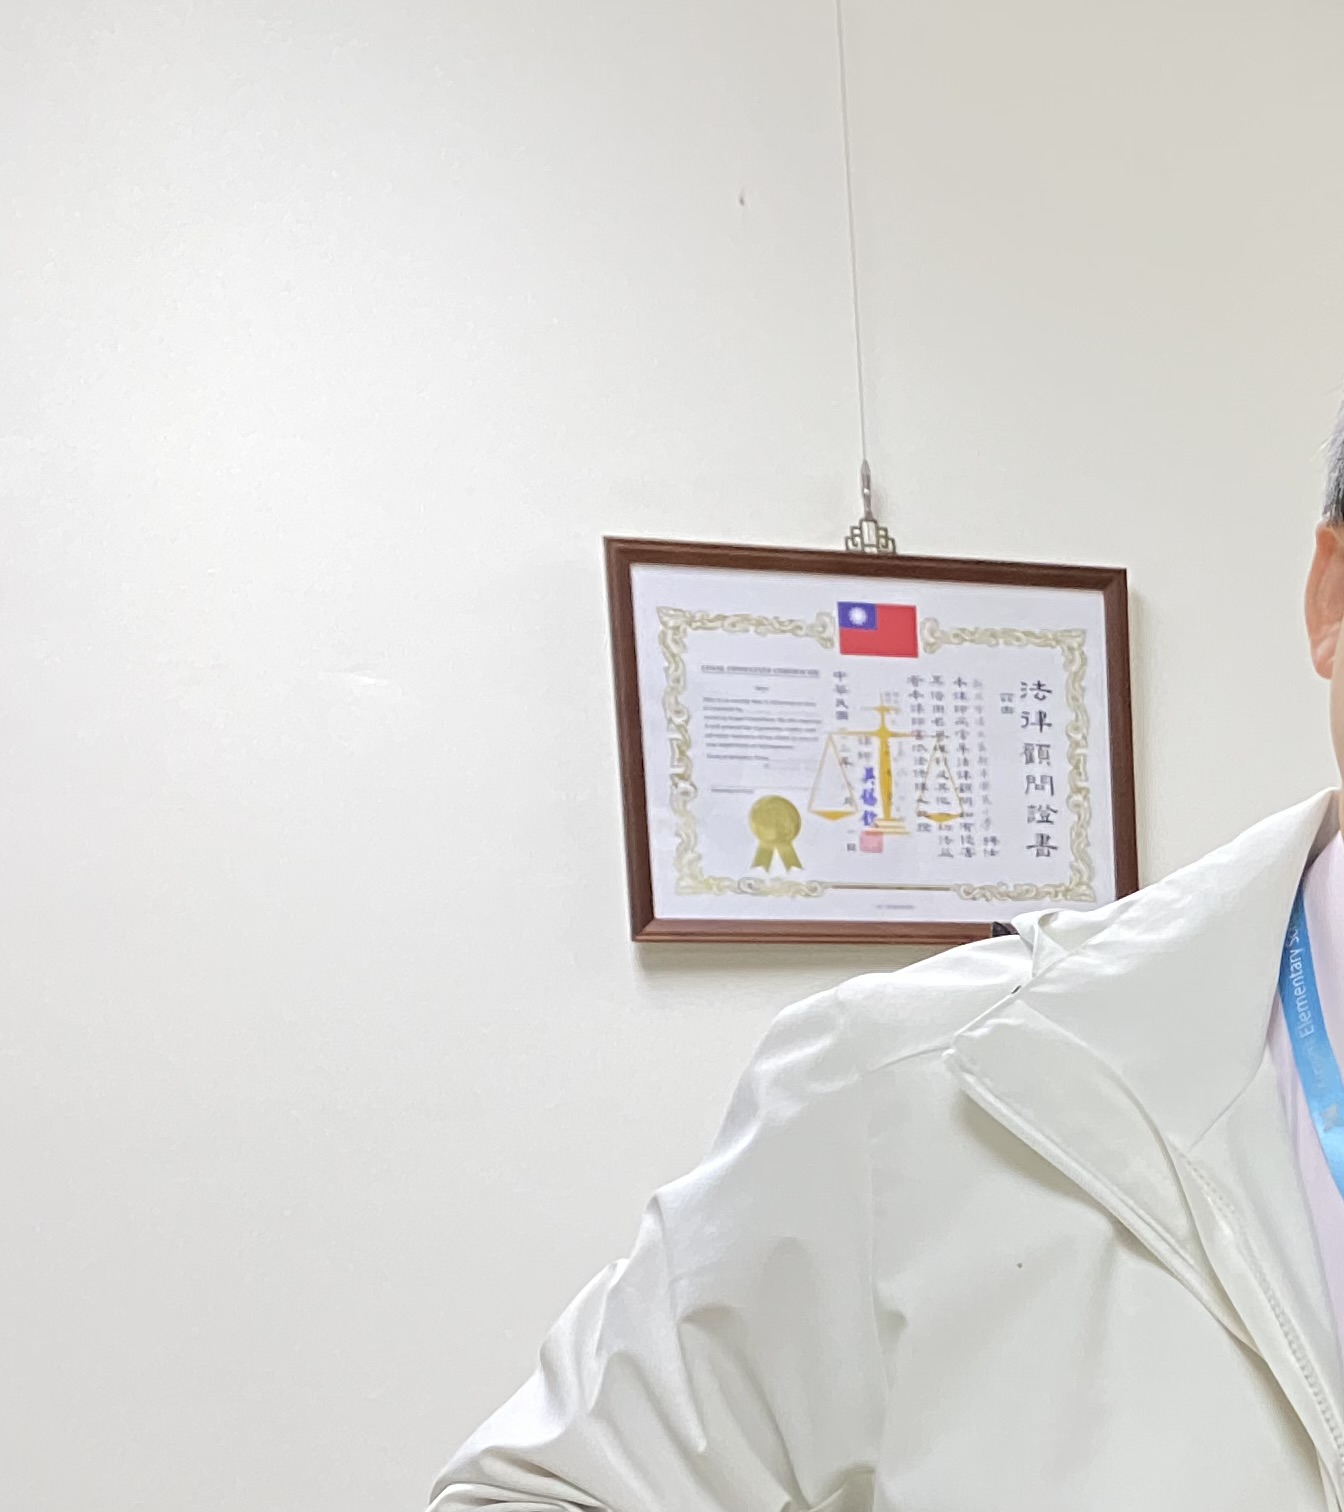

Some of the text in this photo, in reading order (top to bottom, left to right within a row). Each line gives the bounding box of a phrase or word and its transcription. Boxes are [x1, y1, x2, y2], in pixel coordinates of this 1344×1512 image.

[1019, 679, 1059, 859] 法律顧問證書
[1287, 948, 1315, 1038] Elementary
